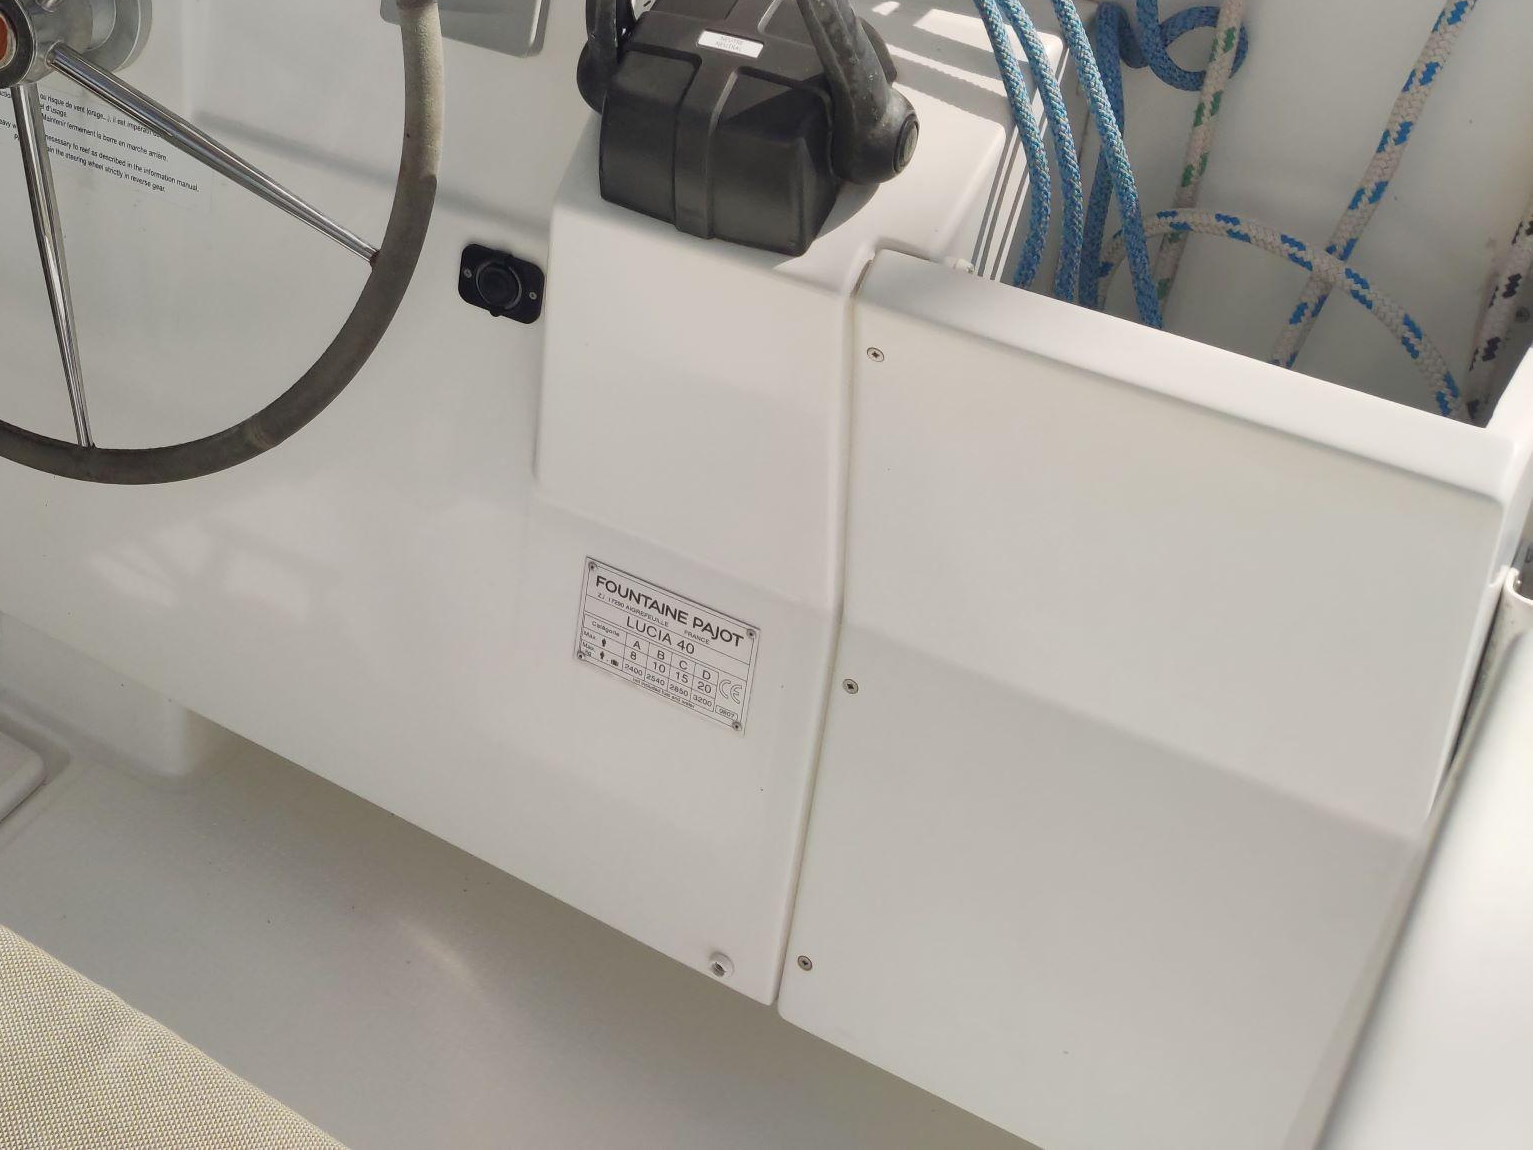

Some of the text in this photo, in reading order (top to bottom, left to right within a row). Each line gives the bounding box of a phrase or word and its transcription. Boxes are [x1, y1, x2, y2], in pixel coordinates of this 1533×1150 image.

[48, 94, 64, 106] risque
[74, 104, 86, 113] vent
[67, 122, 96, 137] fermement
[97, 130, 102, 140] la
[102, 134, 117, 144] barre
[127, 142, 148, 155] marche
[45, 134, 71, 150] necessary
[80, 146, 90, 154] reef
[99, 152, 126, 166] described
[134, 163, 142, 172] the
[143, 168, 176, 184] information
[56, 147, 64, 157] the
[65, 152, 86, 166] steering
[88, 160, 104, 170] wheel
[105, 166, 124, 178] strictly
[131, 175, 151, 187] reverse
[596, 575, 744, 647] FOUNTAINE PAJOT
[626, 604, 669, 627] AIGREFEUILLE
[684, 629, 711, 645] FRANCE
[626, 616, 696, 655] LUCIA 40
[630, 651, 637, 660] 8
[653, 662, 666, 673] 10
[676, 671, 689, 684] 15
[697, 681, 712, 694] 20
[633, 640, 641, 650] A
[657, 650, 665, 660] B
[679, 660, 688, 670] C
[702, 670, 711, 680] D
[624, 663, 643, 676] 2400
[646, 673, 666, 686] 2540
[669, 683, 689, 697] 2850
[693, 694, 712, 707] 3200
